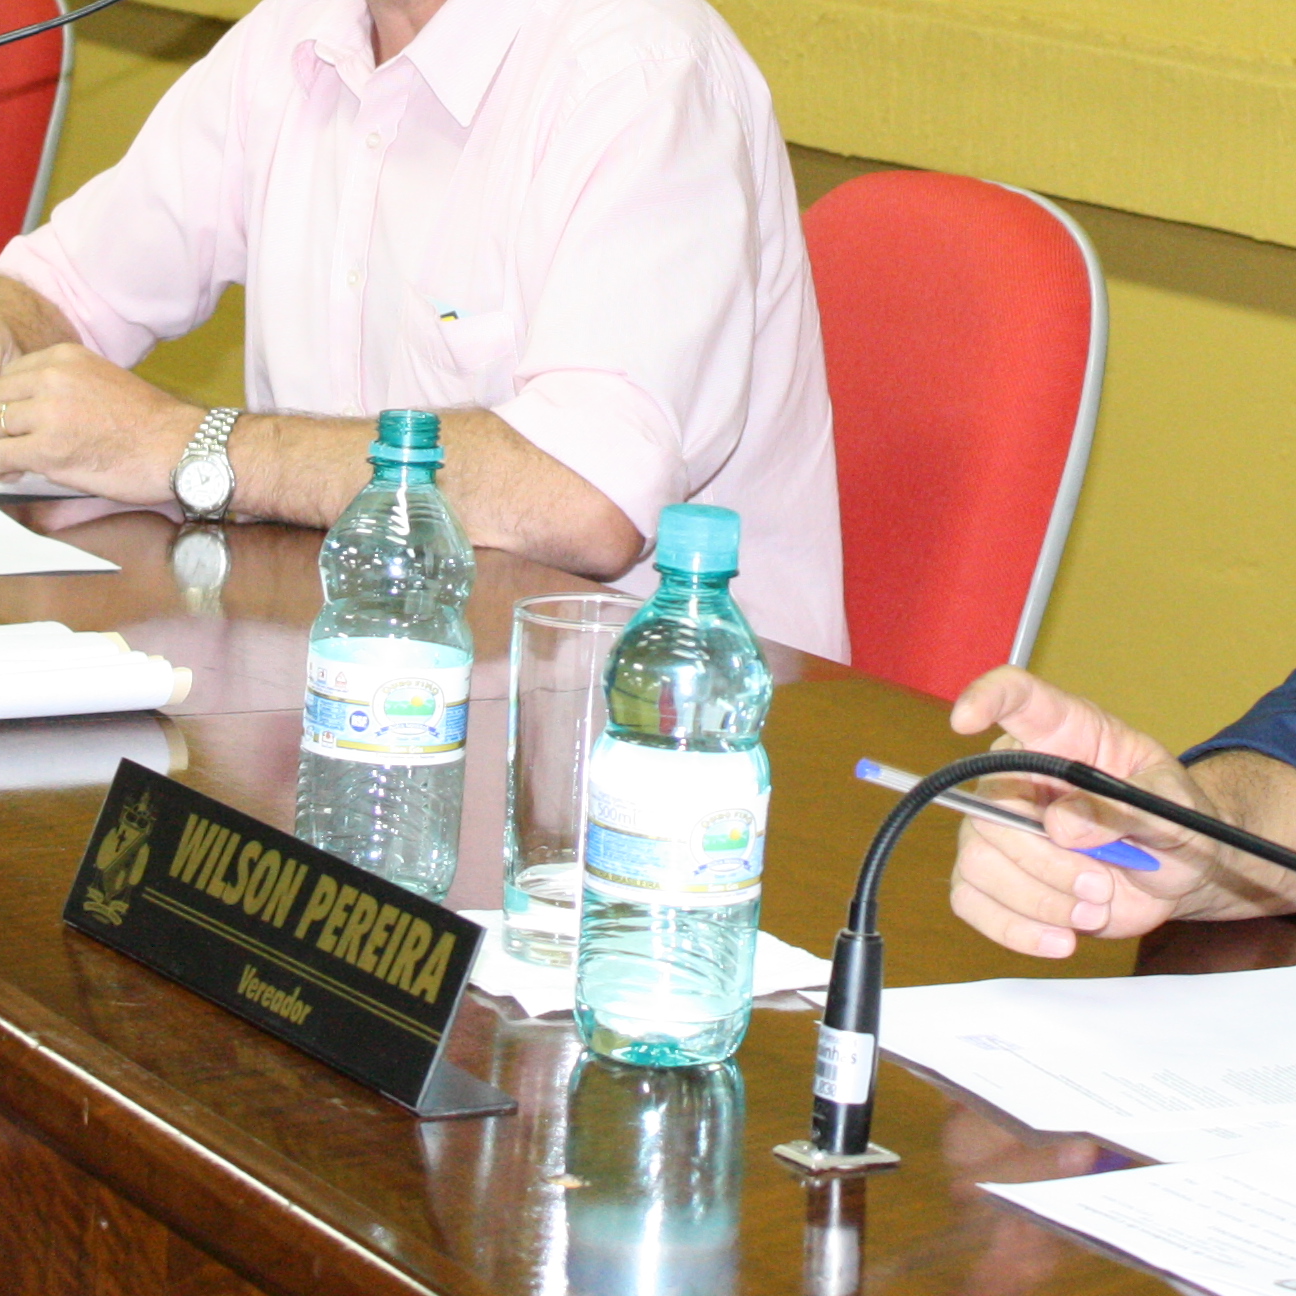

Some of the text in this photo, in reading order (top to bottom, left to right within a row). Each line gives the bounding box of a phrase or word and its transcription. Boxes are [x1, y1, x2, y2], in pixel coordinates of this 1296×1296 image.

[169, 813, 457, 1004] WILSON PEREIRA
[237, 963, 313, 1026] Vereador
